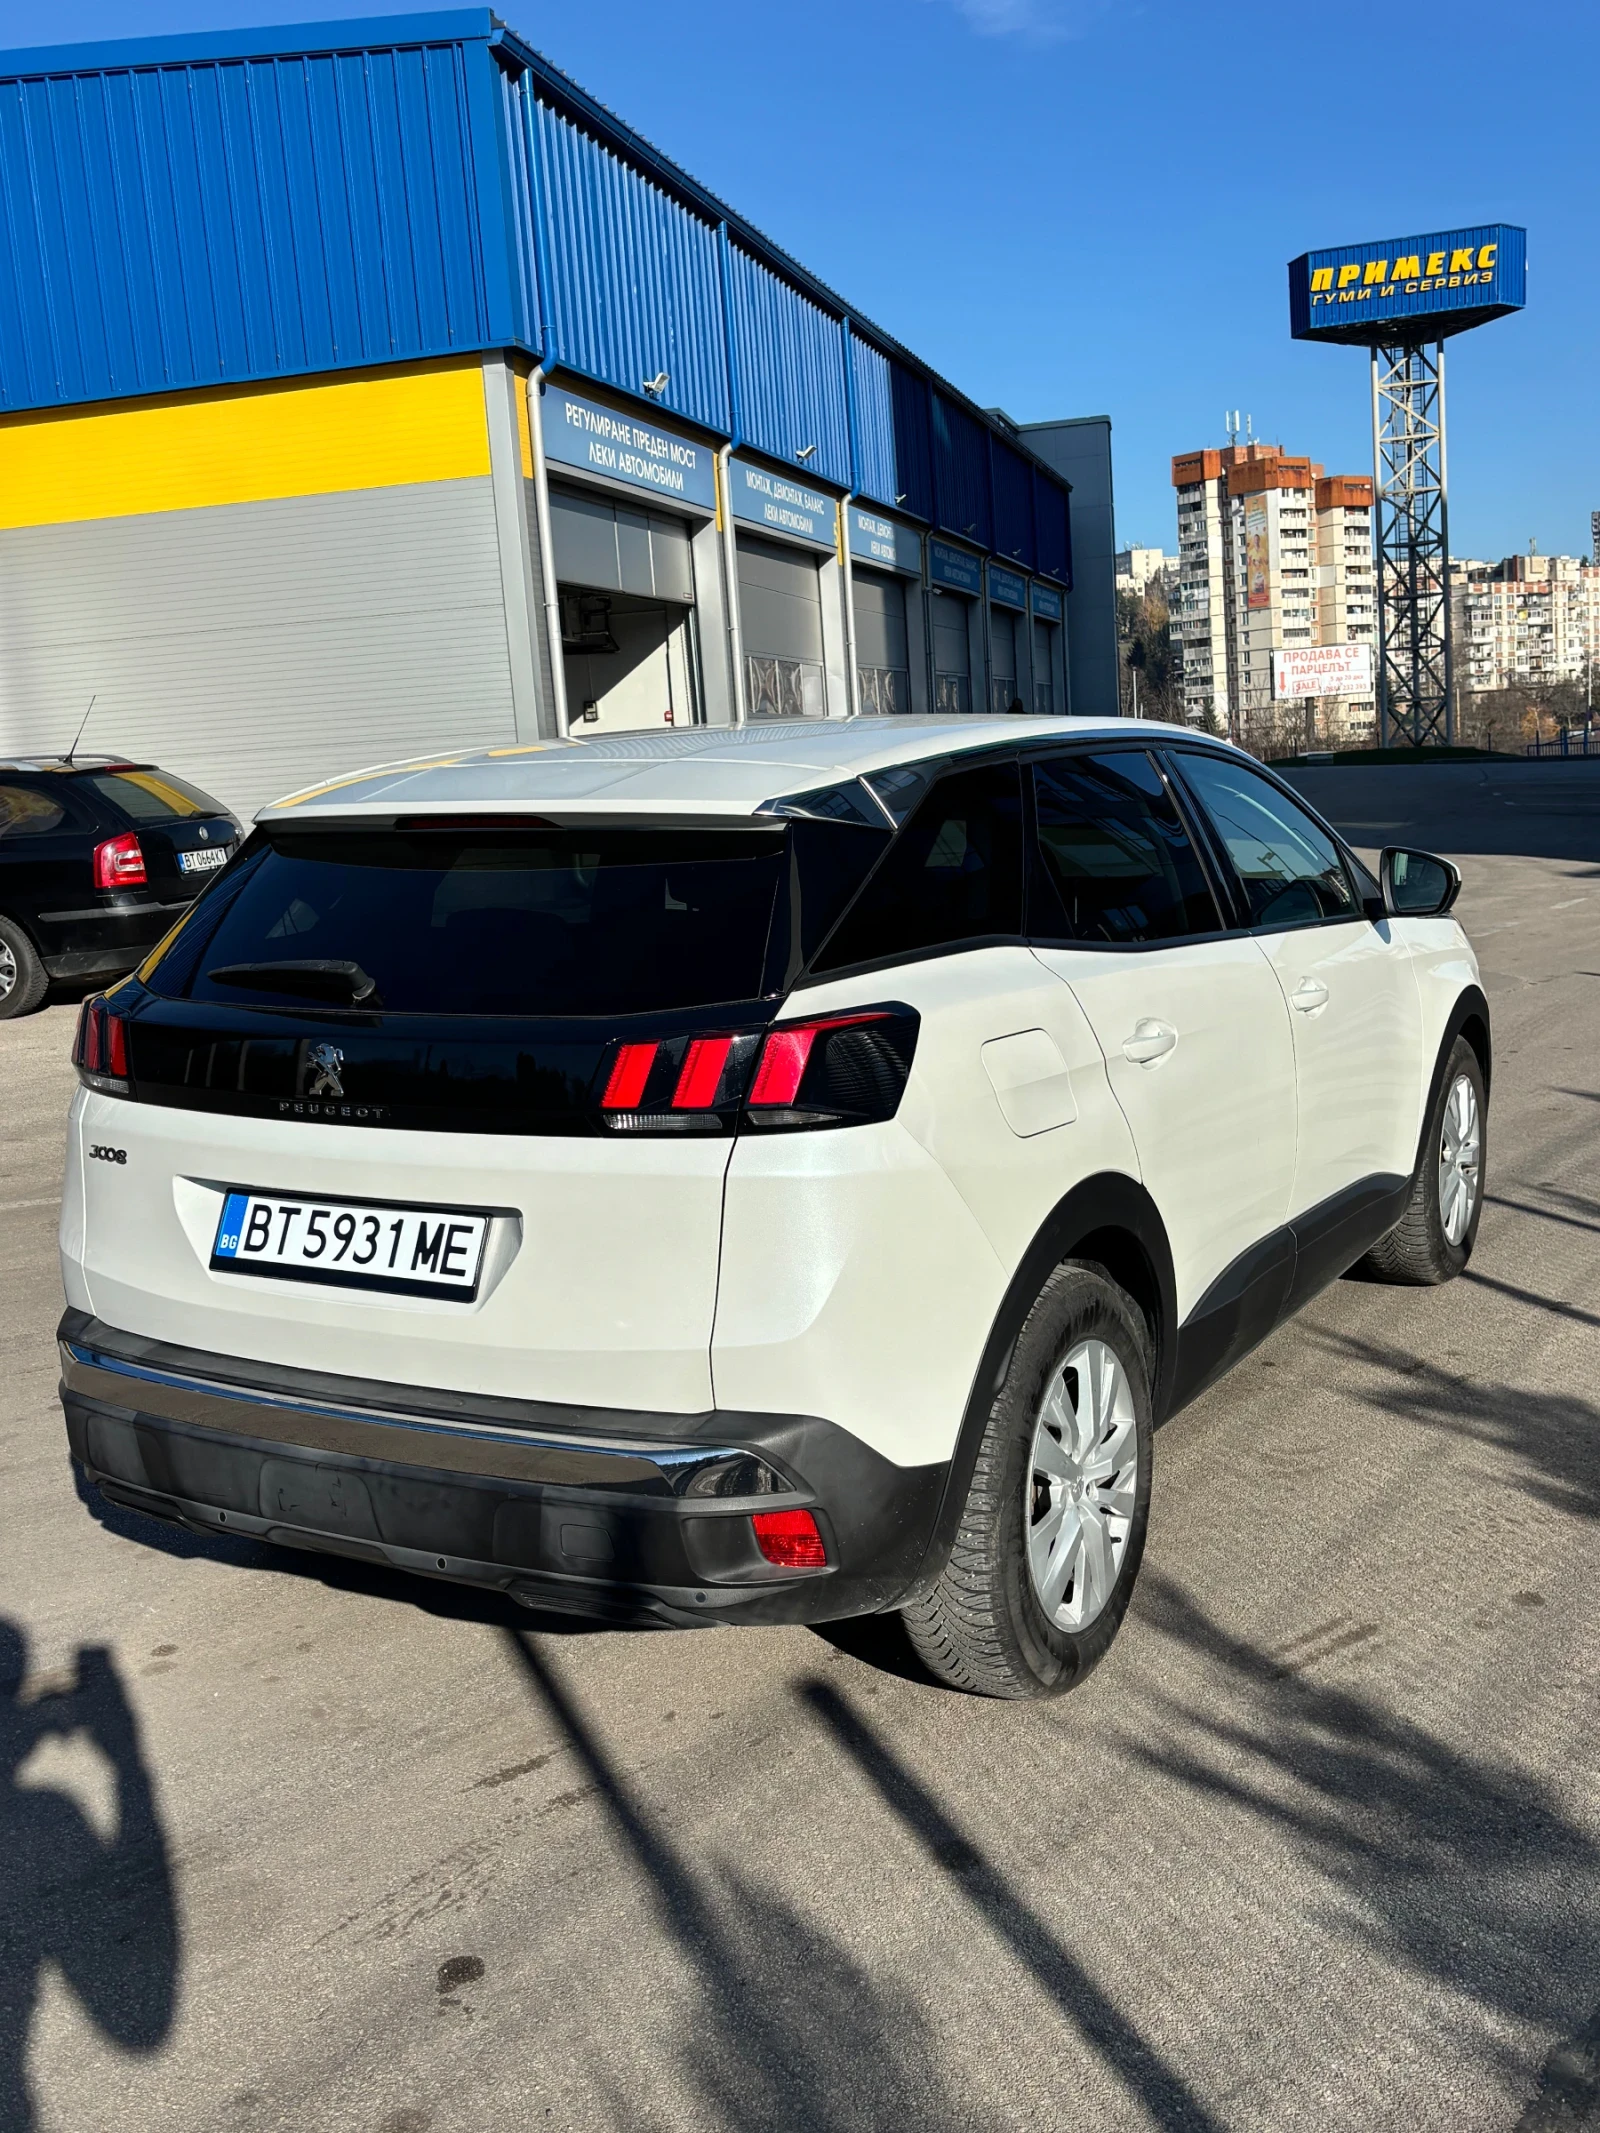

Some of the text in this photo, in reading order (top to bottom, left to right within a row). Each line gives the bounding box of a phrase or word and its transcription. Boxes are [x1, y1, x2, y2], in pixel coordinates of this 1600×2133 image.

[1310, 244, 1497, 292] ПРИМЕКС
[1312, 271, 1493, 306] ГУМИ И СЕРВИЗ
[565, 402, 696, 470] РЕГУЛИРАНЕ ПРЕДЕН МОСТ
[589, 441, 684, 491] ЛЕКИ АВТОМОБИЛИ
[1283, 647, 1359, 663] ПРОДАВА СЕ
[1291, 661, 1351, 676] ПАРЦЕЛЪТ
[1295, 680, 1316, 691] SALE
[279, 1101, 384, 1119] PEUGEOT
[89, 1144, 127, 1165] 3008
[220, 1234, 238, 1250] BG
